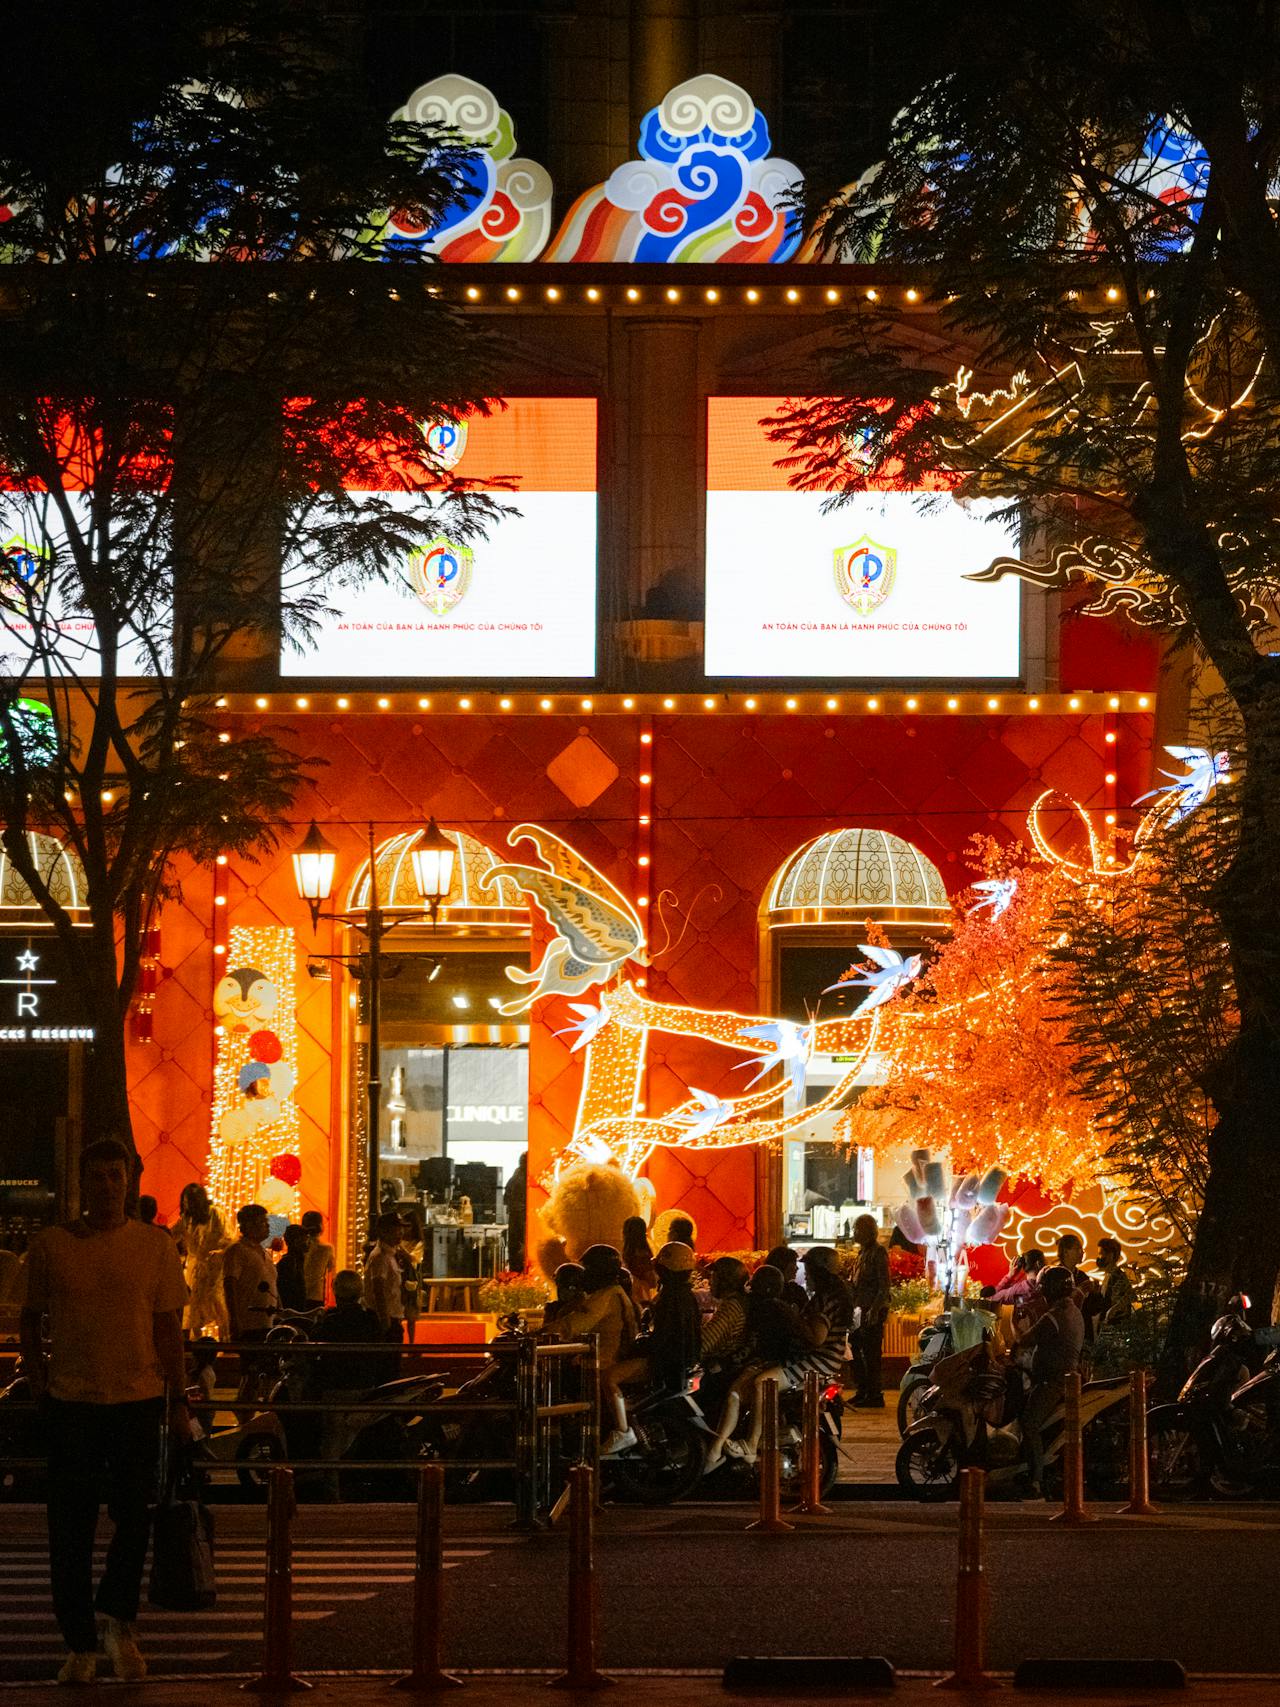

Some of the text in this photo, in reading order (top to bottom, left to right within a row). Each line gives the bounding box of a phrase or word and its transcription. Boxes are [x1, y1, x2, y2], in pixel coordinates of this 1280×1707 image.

[337, 623, 349, 631] AN
[762, 623, 774, 631] AN
[17, 992, 39, 1017] R
